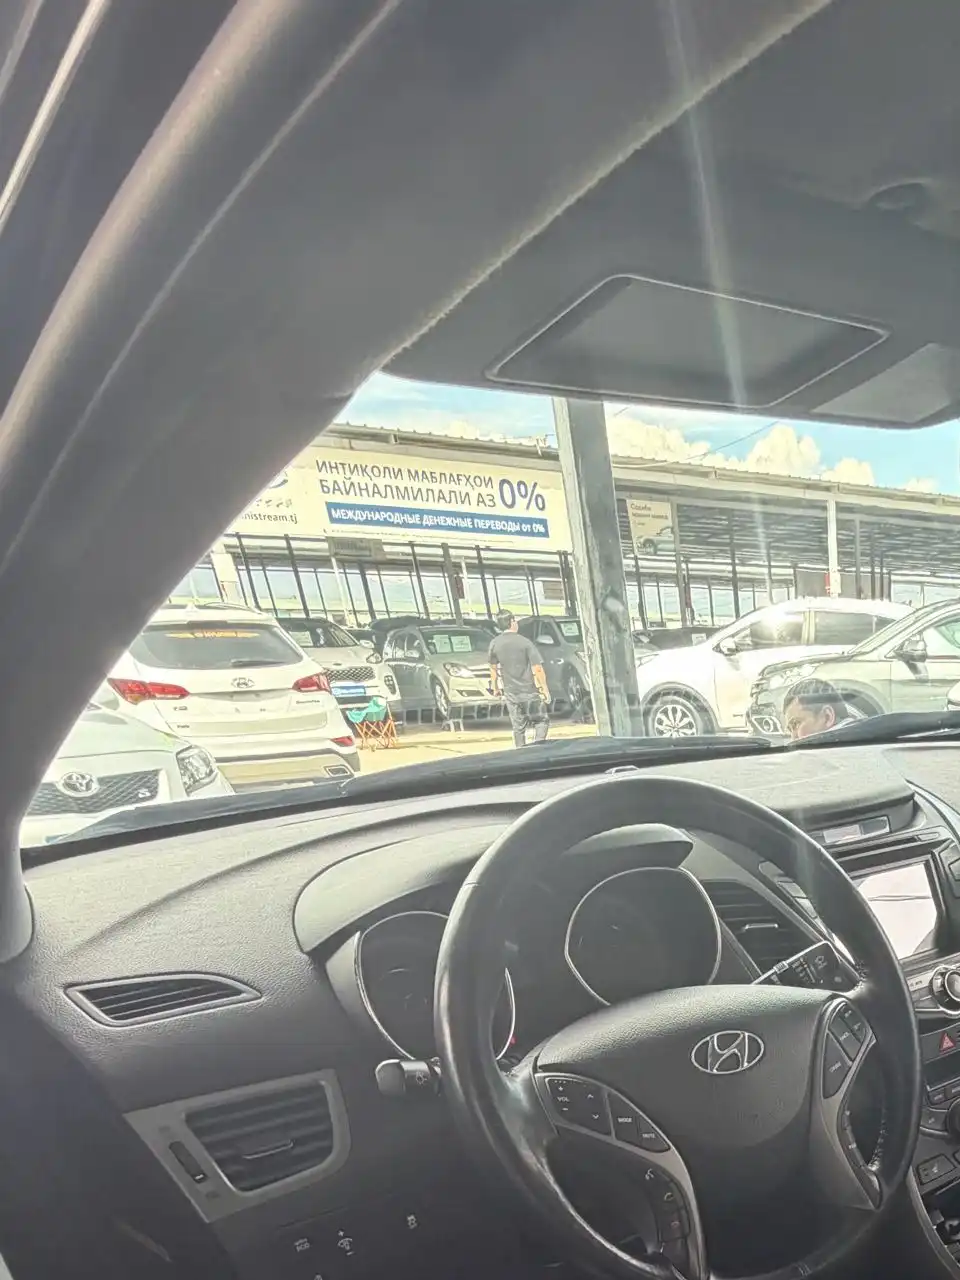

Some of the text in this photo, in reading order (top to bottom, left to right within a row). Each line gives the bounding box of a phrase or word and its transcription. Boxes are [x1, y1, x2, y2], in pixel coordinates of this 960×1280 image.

[319, 476, 497, 508] БАЙНАЛМИЛАЛИ АЗ
[499, 478, 546, 511] 0%
[241, 512, 298, 525] nistream.tj
[331, 507, 421, 525] МЕЖДУНАРОДНЫЕ
[422, 514, 473, 529] ДЕНЕЖНЫЕ
[474, 518, 520, 532] ПЕРЕВОДЫ
